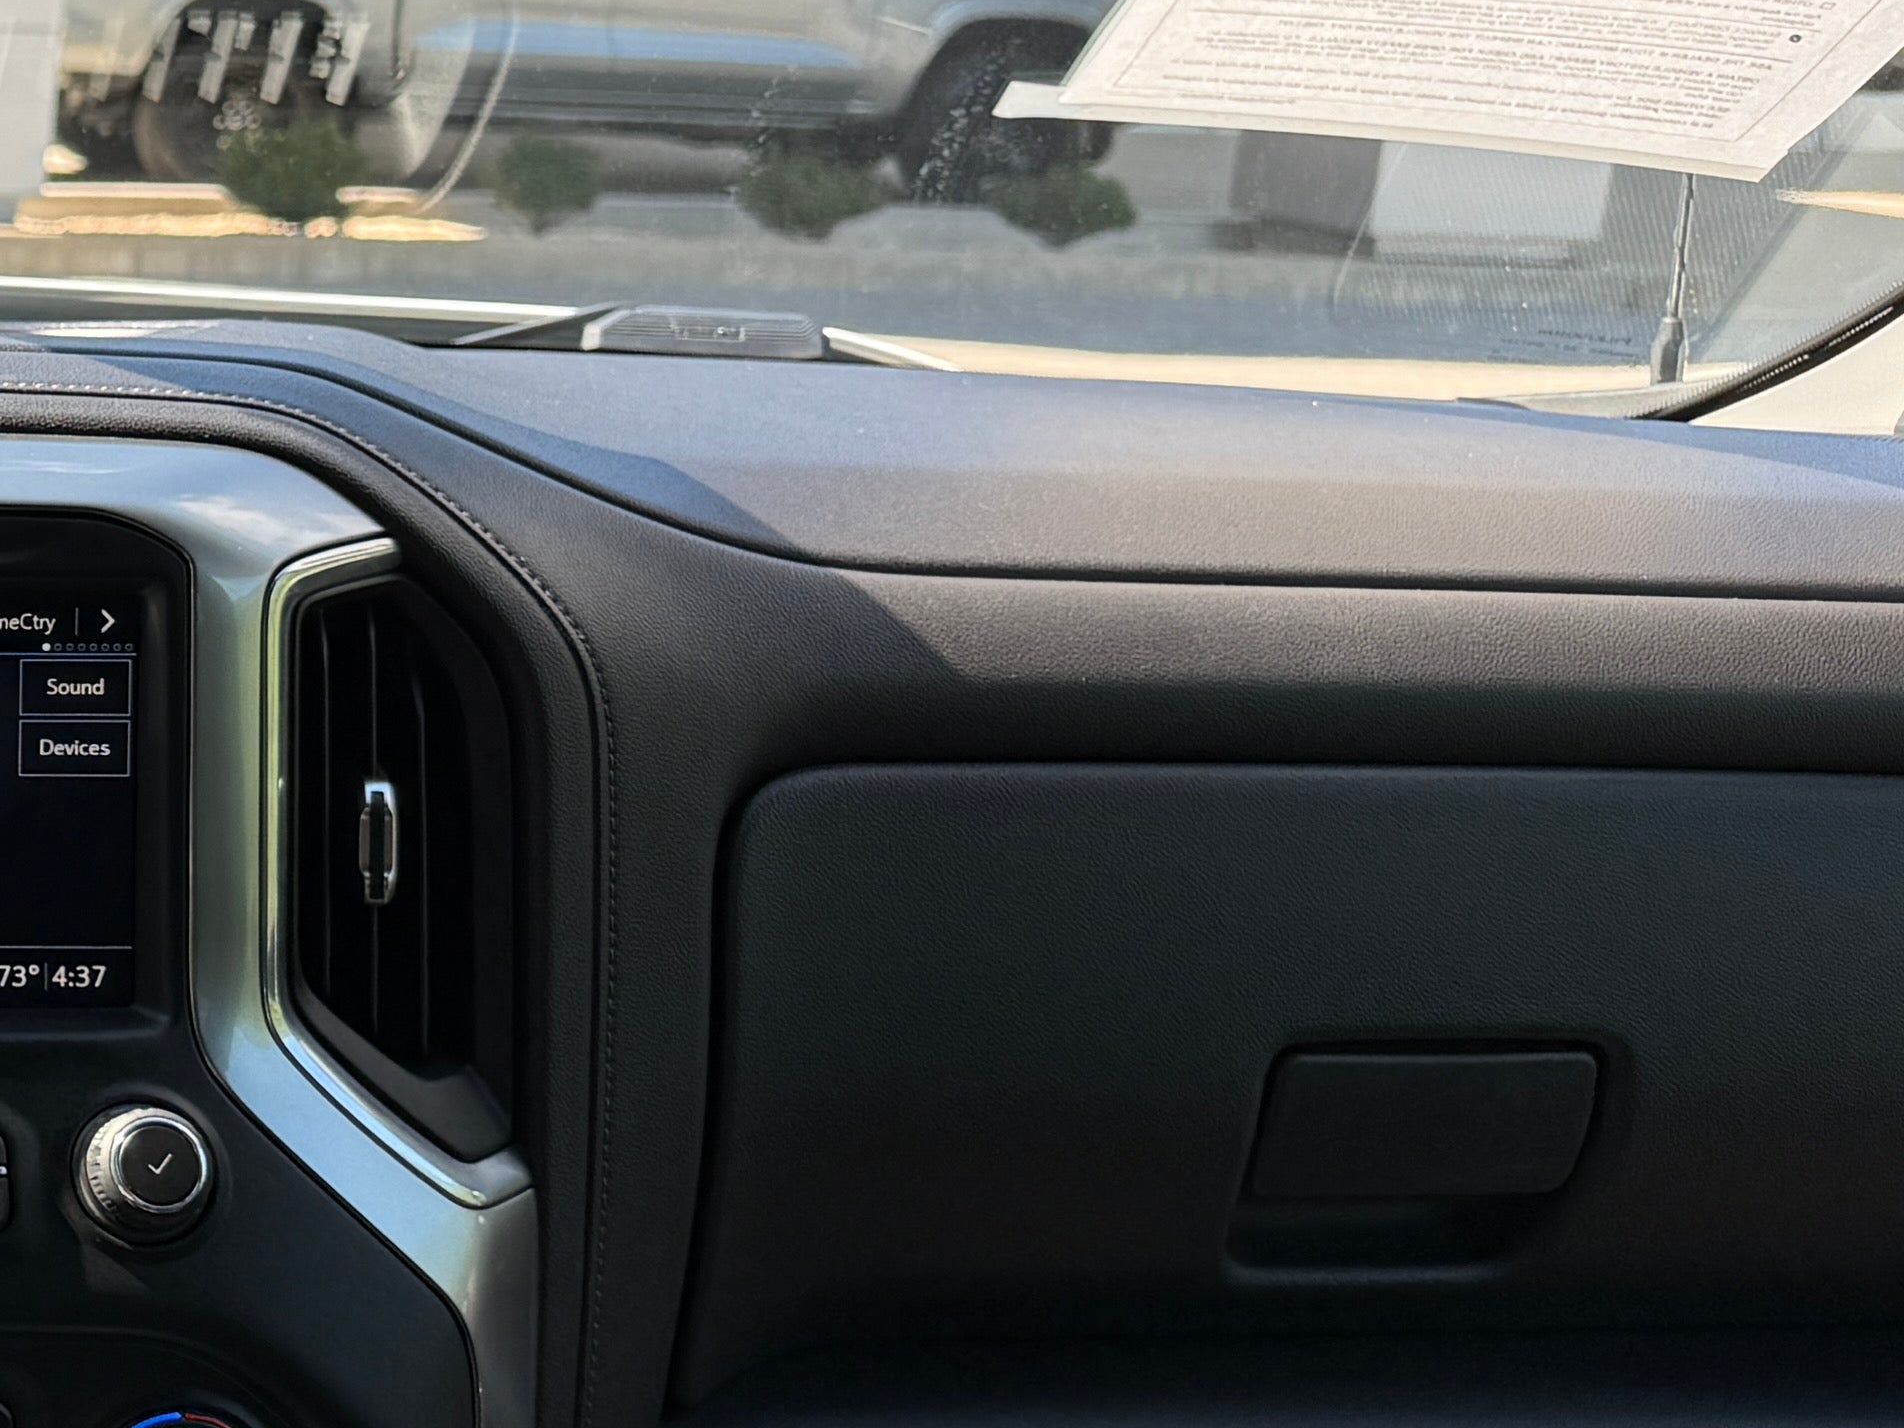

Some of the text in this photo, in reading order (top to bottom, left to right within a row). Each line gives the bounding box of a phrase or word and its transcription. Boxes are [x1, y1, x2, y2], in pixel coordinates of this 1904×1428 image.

[45, 677, 105, 697] Sound
[38, 739, 112, 758] Devices
[51, 964, 107, 988] 4:37
